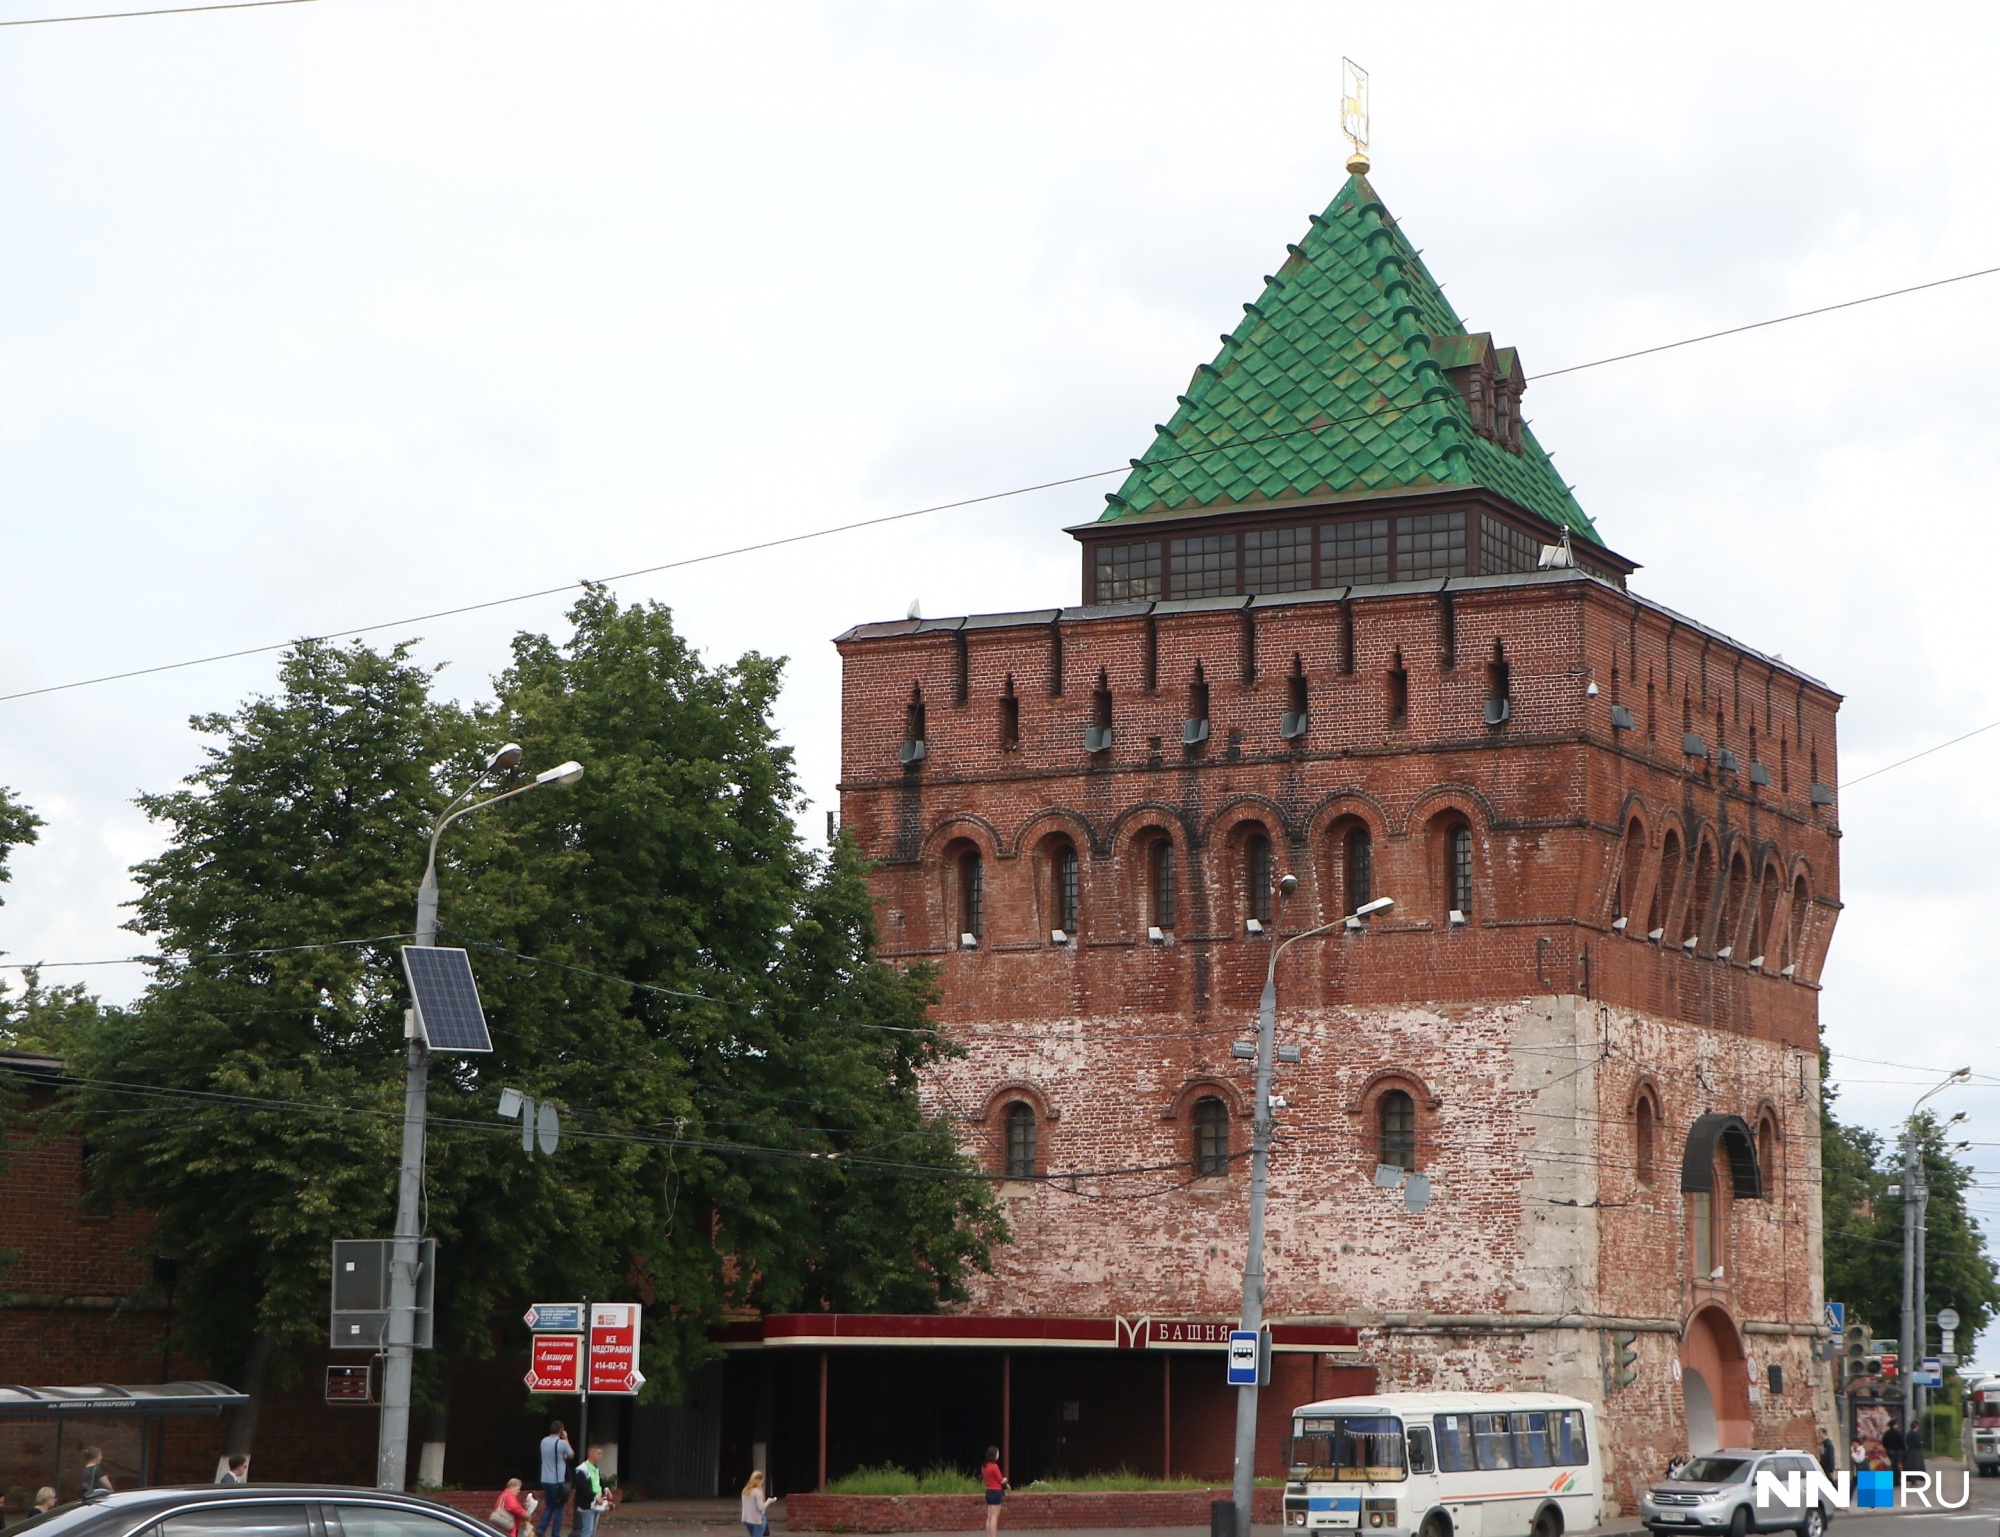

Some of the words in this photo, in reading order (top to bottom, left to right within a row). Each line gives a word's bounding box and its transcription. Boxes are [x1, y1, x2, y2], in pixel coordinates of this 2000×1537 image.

[1159, 1323, 1229, 1341] БАШНЯ
[606, 1335, 617, 1344] ВСЕ
[592, 1345, 632, 1354] МЕДСПРАВКИ
[92, 1400, 136, 1408] ПОЖАРСКОГО
